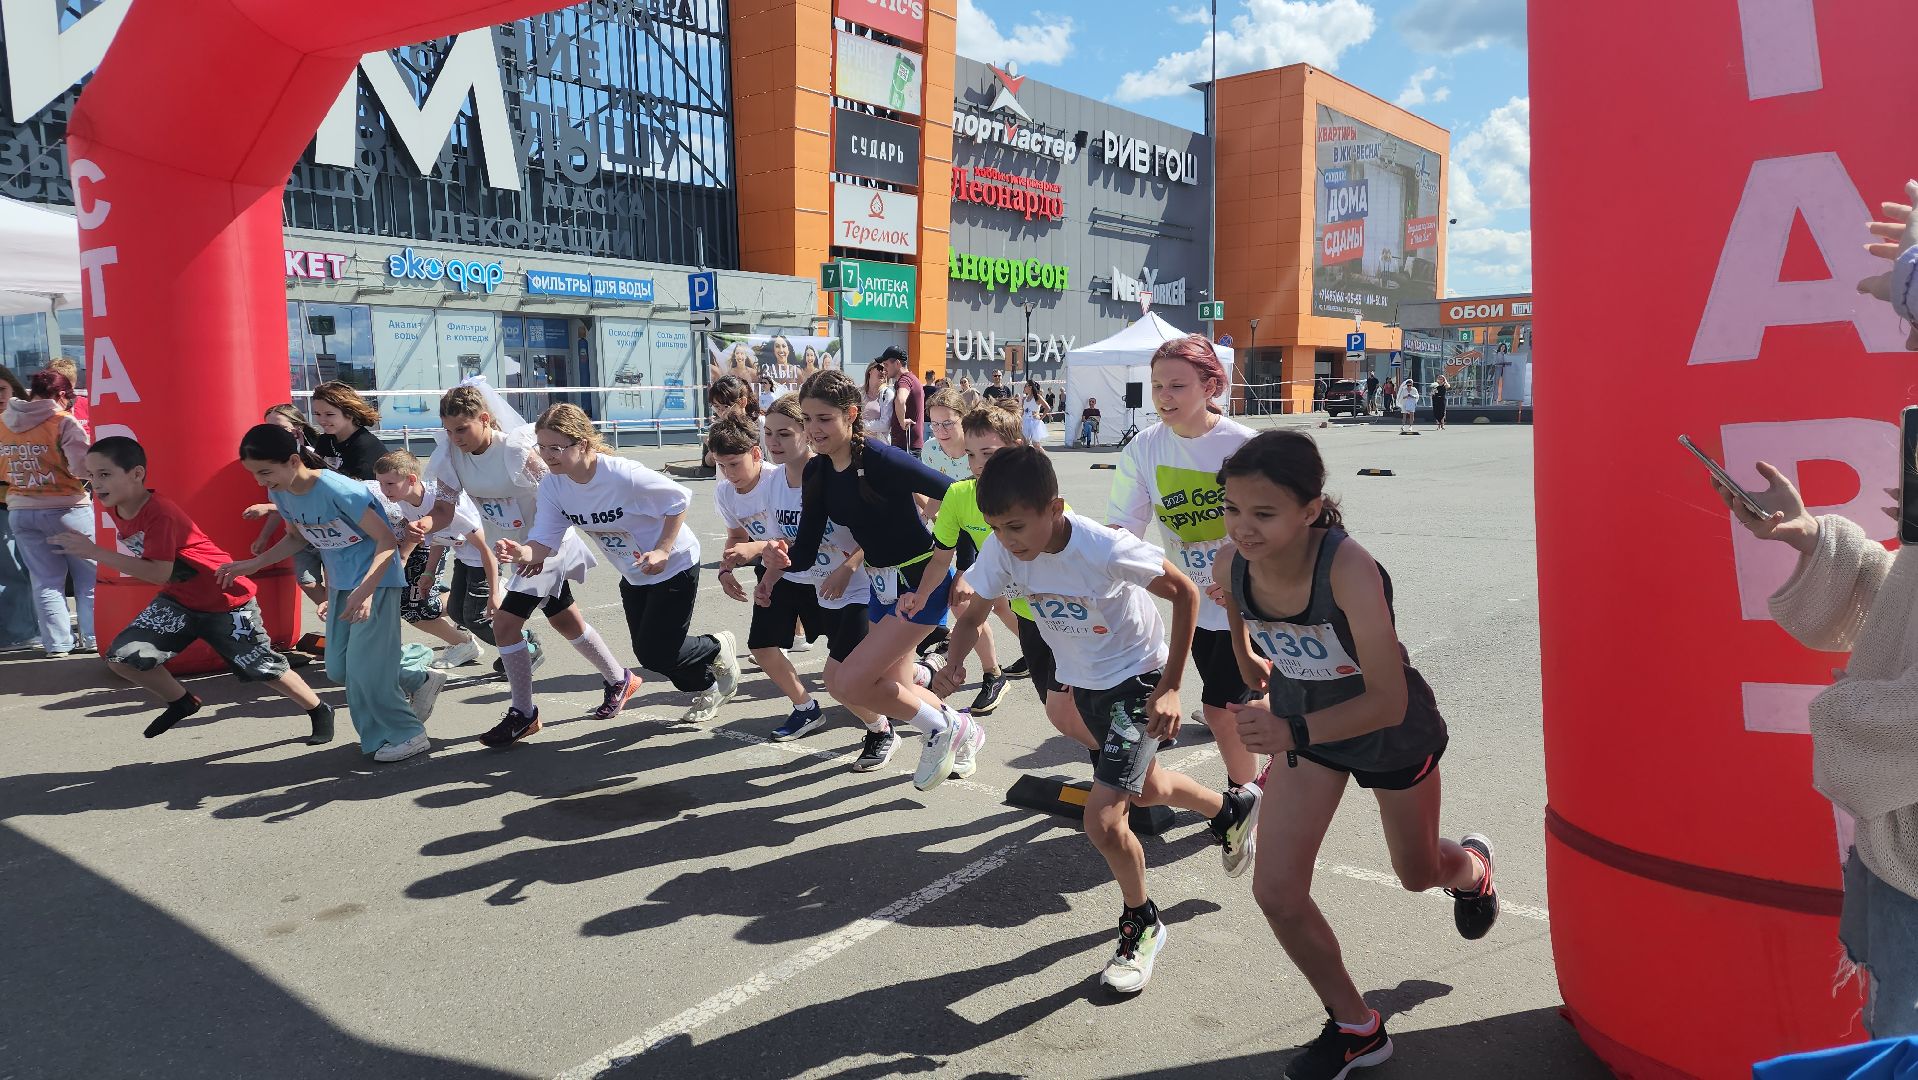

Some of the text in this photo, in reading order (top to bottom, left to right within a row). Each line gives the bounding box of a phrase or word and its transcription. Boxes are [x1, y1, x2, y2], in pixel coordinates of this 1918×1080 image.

[1318, 126, 1357, 142] КВАРТИРЫ
[851, 134, 904, 164] СУДАРЬ
[1104, 129, 1197, 186] РИВ ГОШ
[542, 181, 647, 222] МАСКА
[951, 167, 1064, 222] Леонардо
[1327, 184, 1368, 223] ДОМА
[435, 209, 632, 256] ДЕКОРАЦИИ
[842, 220, 909, 246] Теремок
[1324, 225, 1363, 258] СДАНЫ
[827, 270, 835, 283] 7
[847, 269, 854, 283] 7
[532, 274, 651, 299] ФИЛЬТРЫ ДЛЯ ВОДЫ
[865, 277, 909, 293] АПТЕКА
[866, 292, 909, 310] РИГЛА
[1450, 303, 1504, 320] ОБОИ
[388, 319, 422, 330] Анализ
[447, 322, 487, 333] Фильтры
[394, 333, 418, 342] воды
[454, 334, 489, 343] коттедж
[8, 458, 41, 472] trail
[7, 472, 55, 488] TEAM
[482, 503, 504, 518] 61
[590, 507, 624, 525] BOSS
[306, 527, 342, 539] 174
[600, 536, 627, 548] 22
[1030, 600, 1088, 621] 129
[1257, 631, 1328, 660] 130
